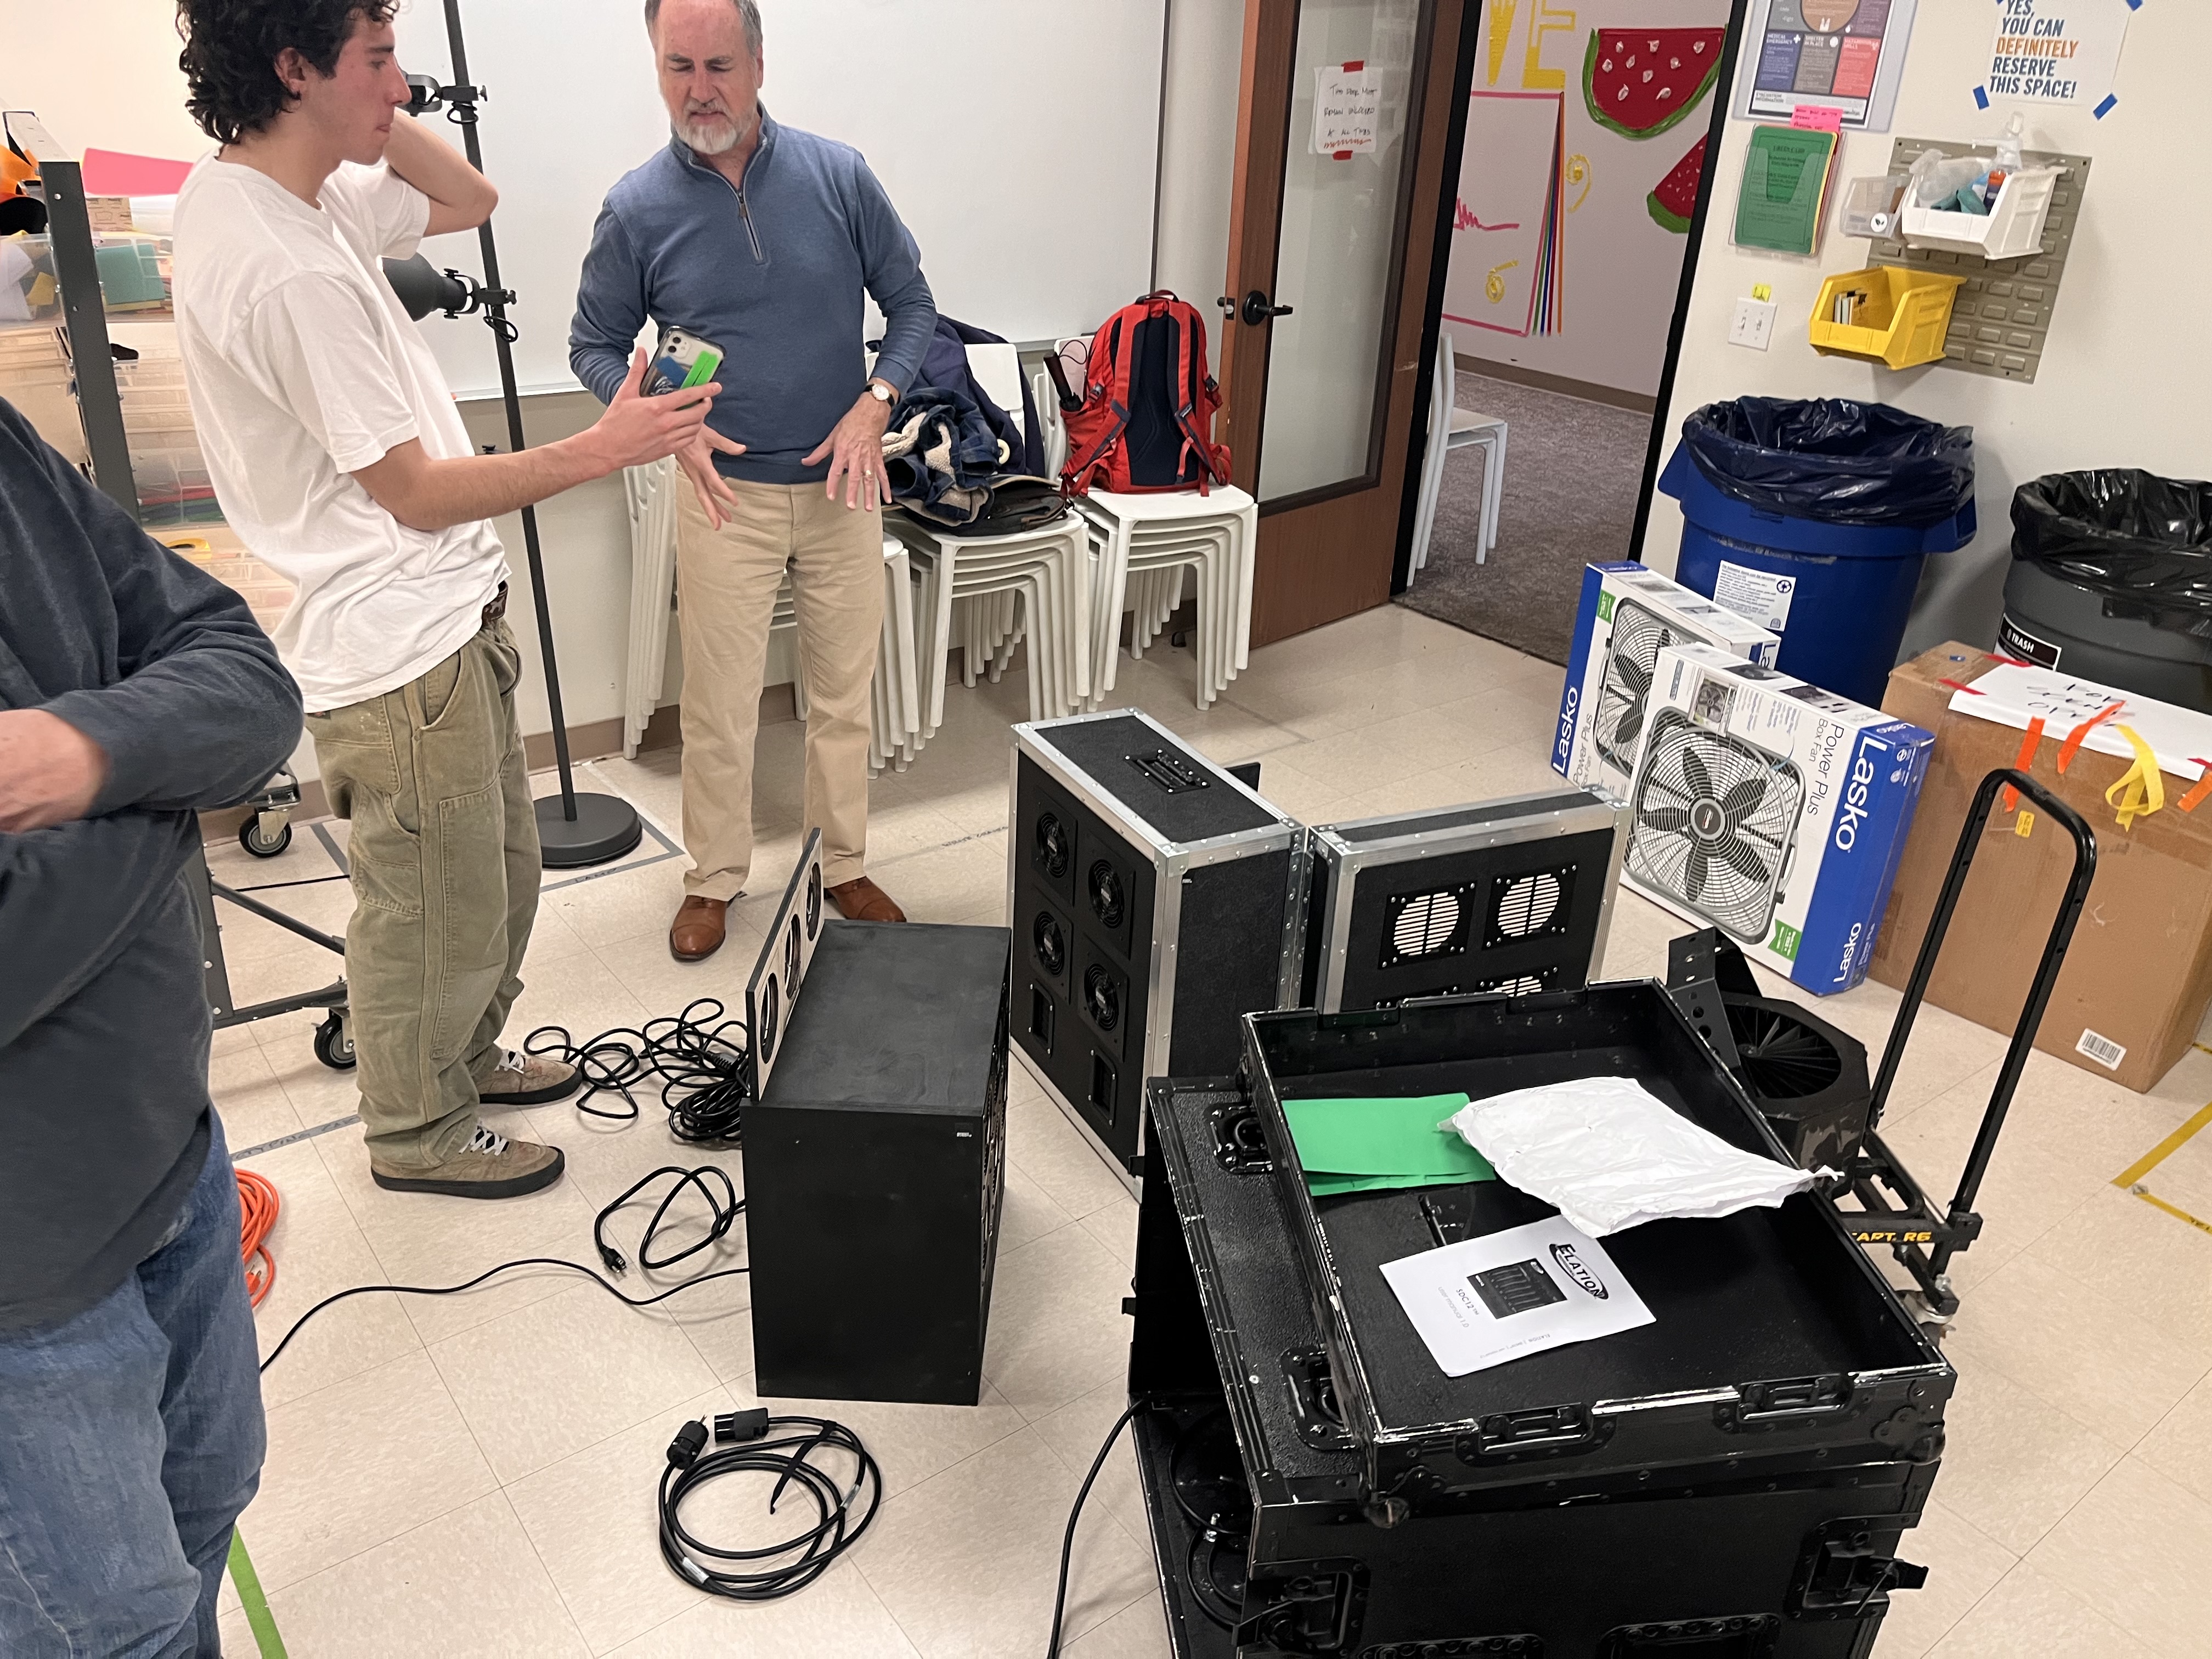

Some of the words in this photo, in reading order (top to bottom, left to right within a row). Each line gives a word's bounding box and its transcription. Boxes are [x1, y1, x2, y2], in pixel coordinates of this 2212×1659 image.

[2007, 0, 2034, 20] YES,
[2002, 17, 2031, 35] YOU
[2033, 19, 2064, 37] CAN
[1996, 37, 2079, 59] DEFINITELY
[1992, 57, 2057, 77] RESERVE
[1990, 76, 2020, 94] THIS
[2023, 78, 2077, 99] SPACE!
[2011, 632, 2034, 653] TRASH
[1553, 686, 1578, 774] Lasko
[1815, 718, 1828, 740] Box
[1573, 743, 1587, 786] Power
[1581, 713, 1593, 742] Plus
[1809, 742, 1821, 762] Fan
[1818, 723, 1844, 779] Power
[1807, 780, 1829, 816] Plus
[1836, 736, 1887, 851] Lasko
[1833, 922, 1862, 983] Lasko
[1903, 1232, 1932, 1242] R6
[1557, 1244, 1605, 1297] ELATION
